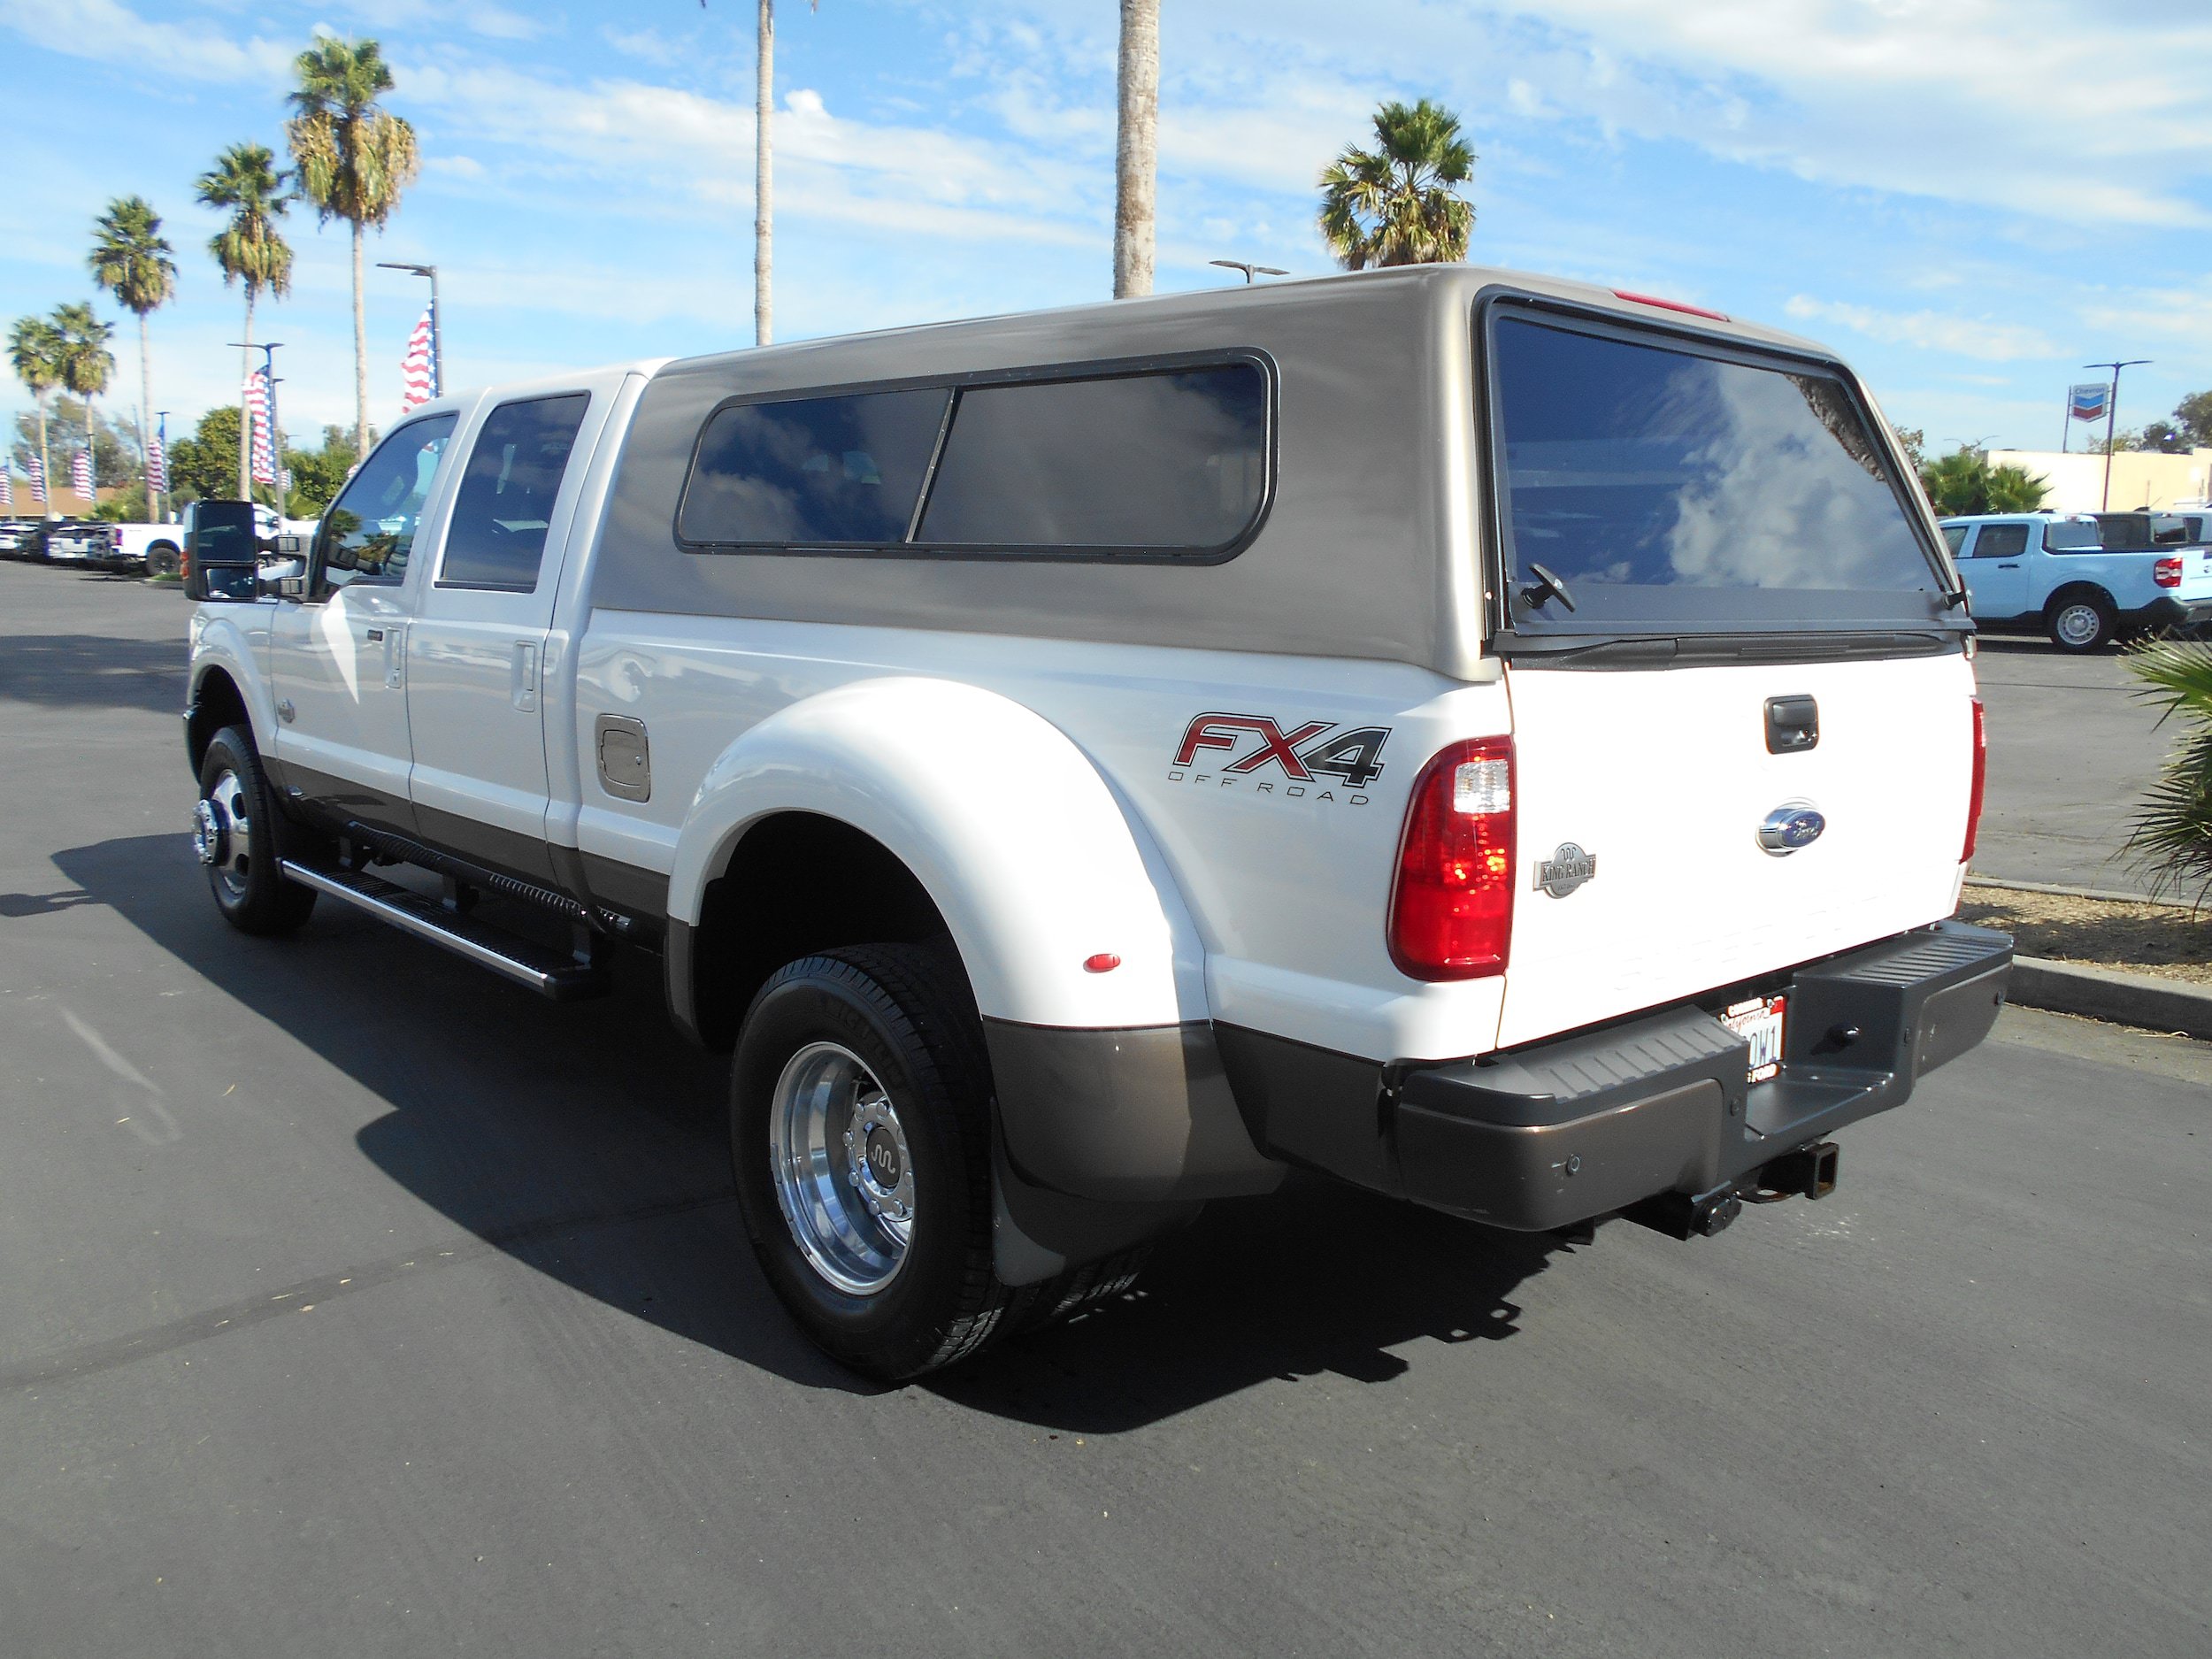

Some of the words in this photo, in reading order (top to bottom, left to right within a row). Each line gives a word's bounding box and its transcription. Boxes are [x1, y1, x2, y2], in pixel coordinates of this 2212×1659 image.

[1172, 711, 1393, 788] FX4
[1167, 771, 1238, 787] OFF
[1256, 782, 1370, 805] ROAD
[1793, 820, 1819, 841] Ford
[1542, 864, 1564, 882] KING
[1565, 856, 1595, 879] RANCH
[1728, 1010, 1770, 1033] alifornia
[1752, 1064, 1777, 1082] FORD
